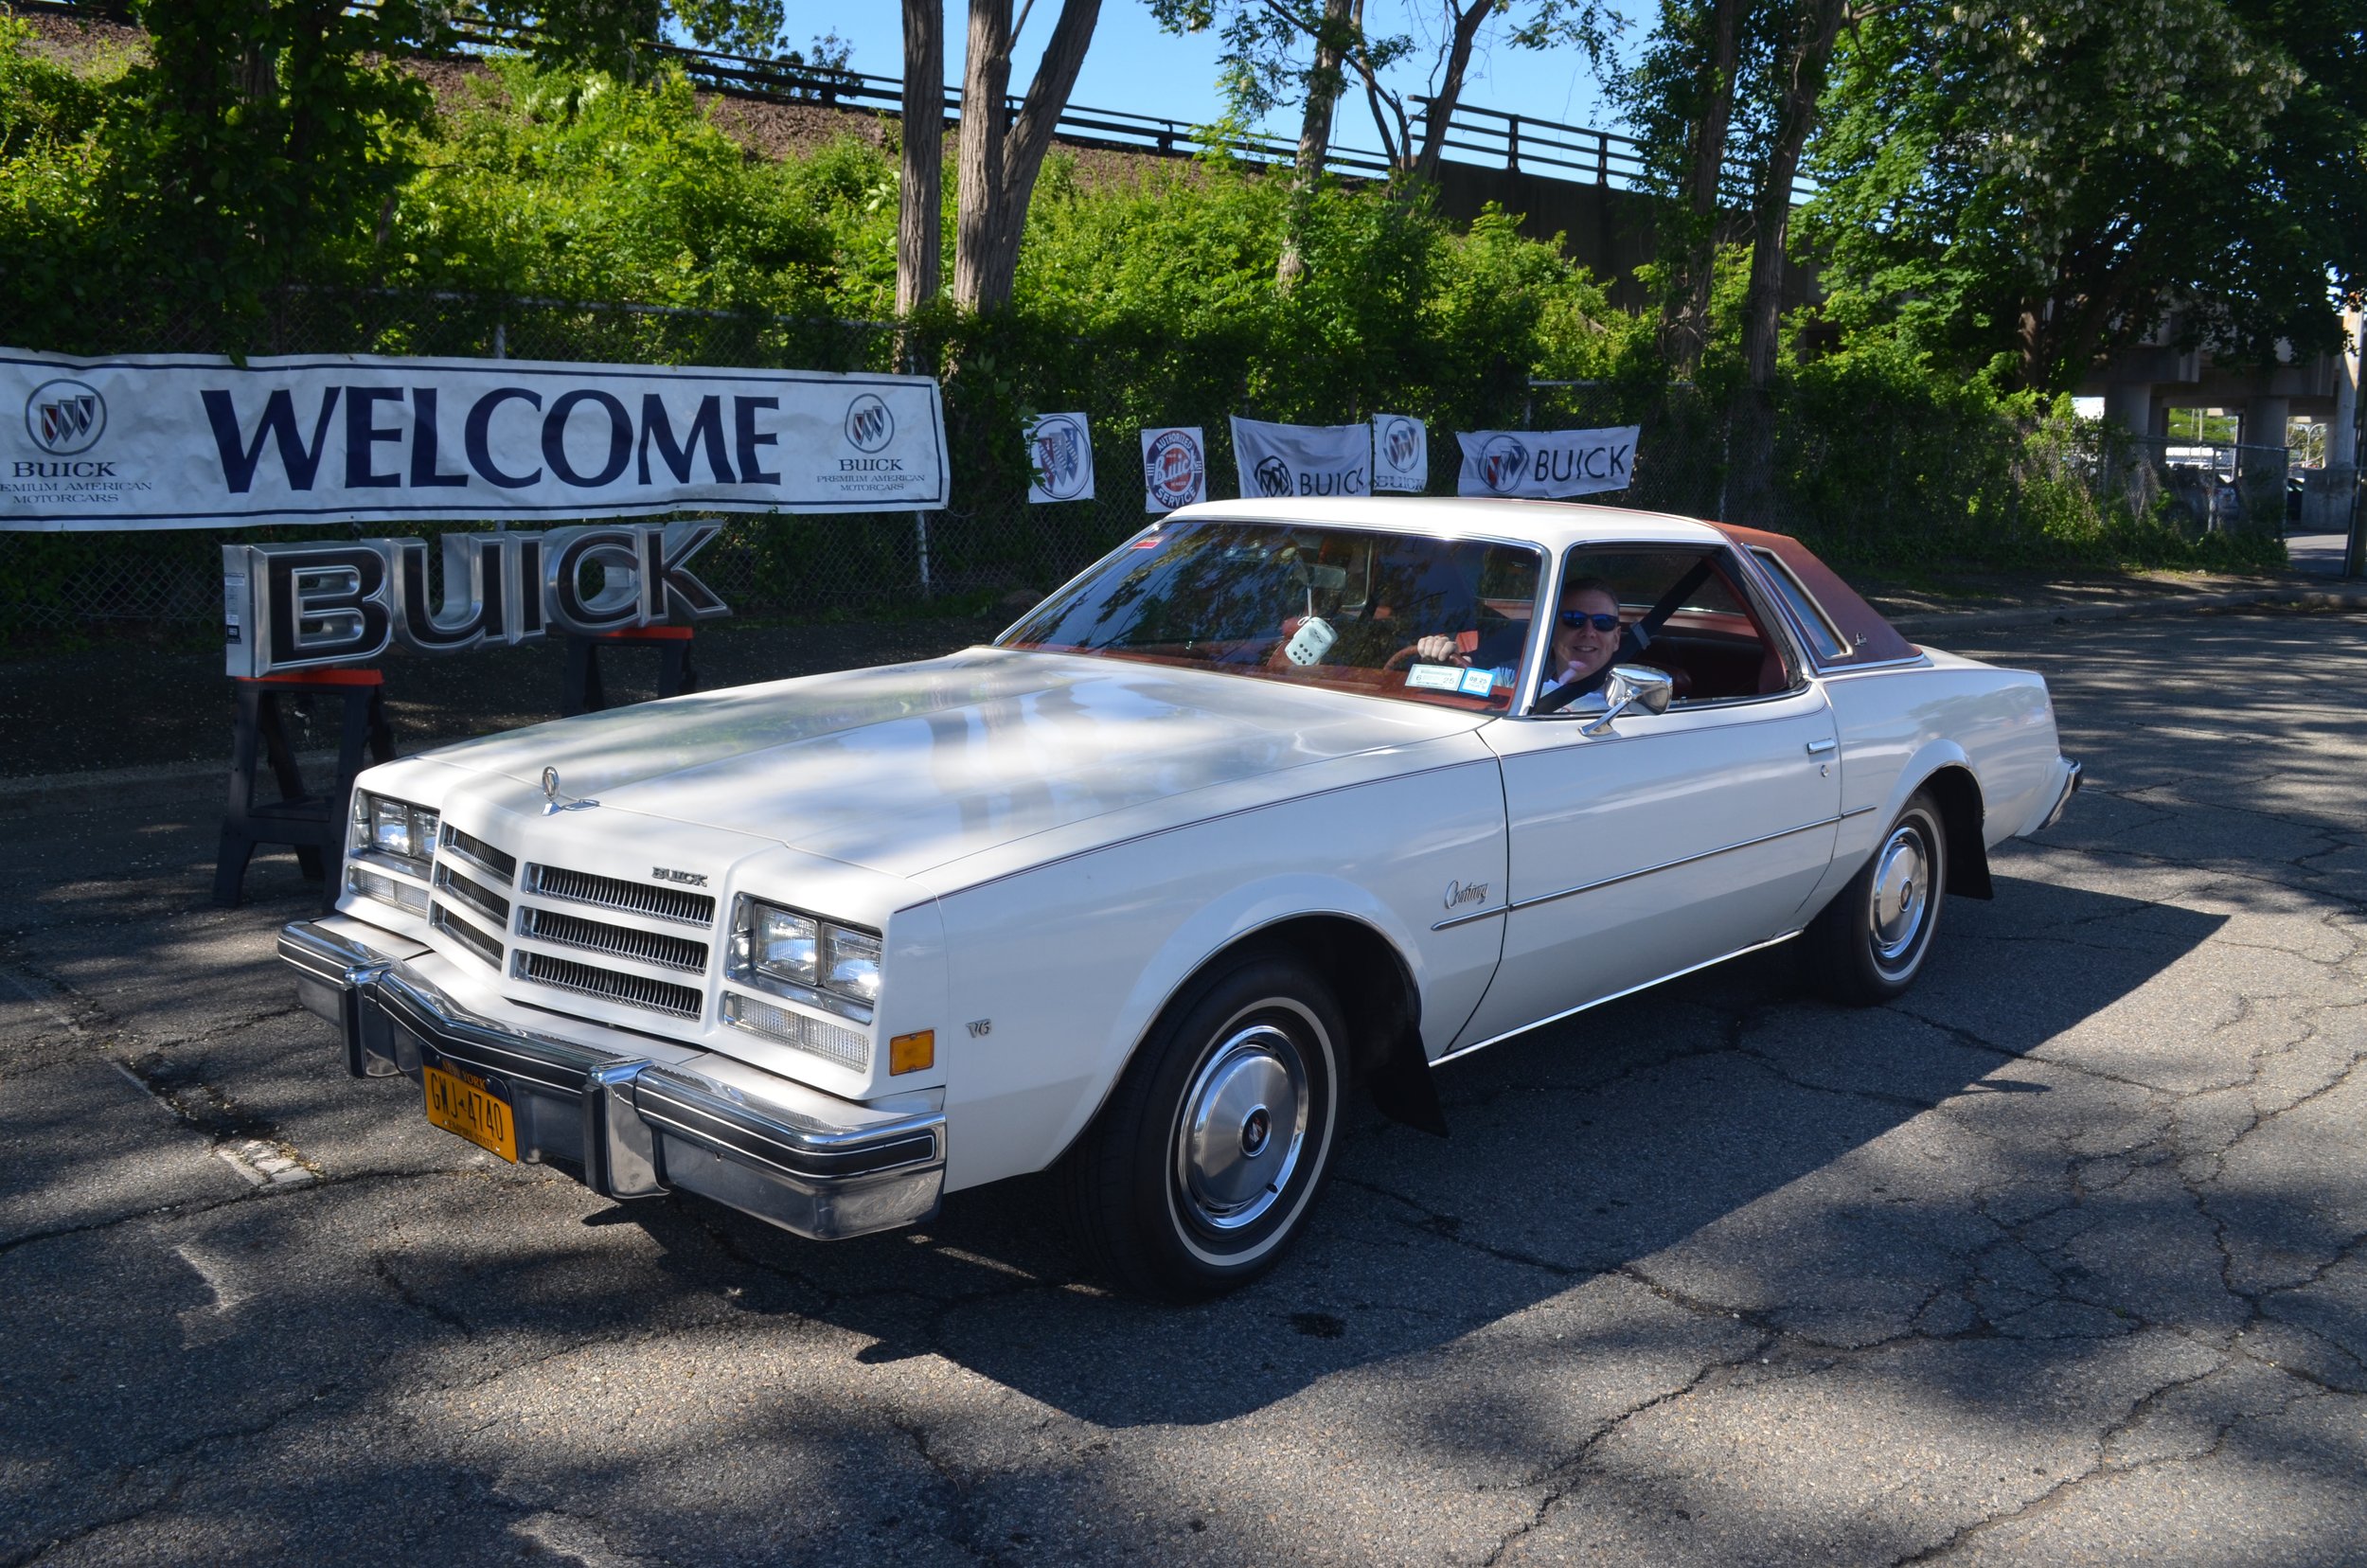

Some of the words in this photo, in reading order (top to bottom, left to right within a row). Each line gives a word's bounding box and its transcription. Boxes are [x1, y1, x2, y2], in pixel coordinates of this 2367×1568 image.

[200, 386, 781, 493] WELCOME
[1155, 432, 1193, 452] AUTHORIZED
[11, 461, 117, 477] BUICK
[838, 458, 903, 472] BUICK
[1535, 444, 1629, 482] BUICK
[0, 482, 58, 492] EMIUM
[63, 481, 152, 491] AMERICAN
[816, 475, 867, 484] PREMIUM
[870, 474, 925, 483] AMERICAN
[840, 483, 904, 491] MOTORCARS
[1299, 467, 1363, 496] BUICK
[1376, 475, 1425, 490] BUICK
[13, 493, 119, 505] MOTORCARS
[1155, 486, 1197, 508] SERVICE
[246, 521, 731, 676] BUICK
[651, 866, 708, 887] BUICK
[966, 1018, 992, 1039] V6
[461, 1069, 488, 1092] YORK
